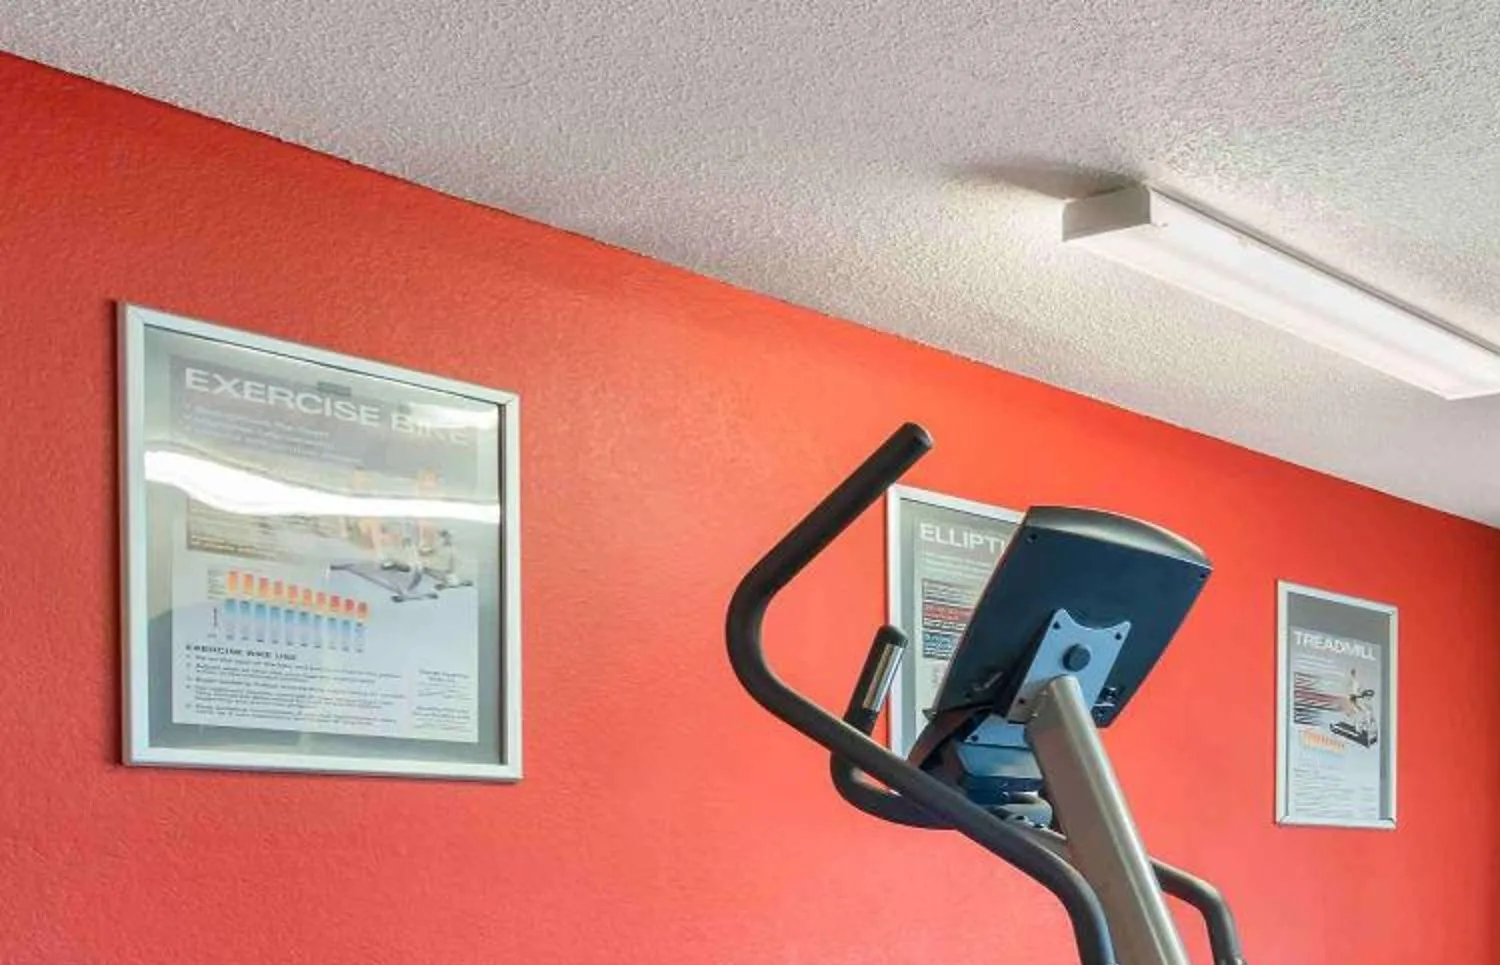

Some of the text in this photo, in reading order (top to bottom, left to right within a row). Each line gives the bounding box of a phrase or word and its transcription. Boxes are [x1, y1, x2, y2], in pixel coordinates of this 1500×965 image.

[185, 367, 382, 427] EXERCISE
[920, 522, 1006, 554] ELLIPTI
[1293, 630, 1377, 661] TREADMILL
